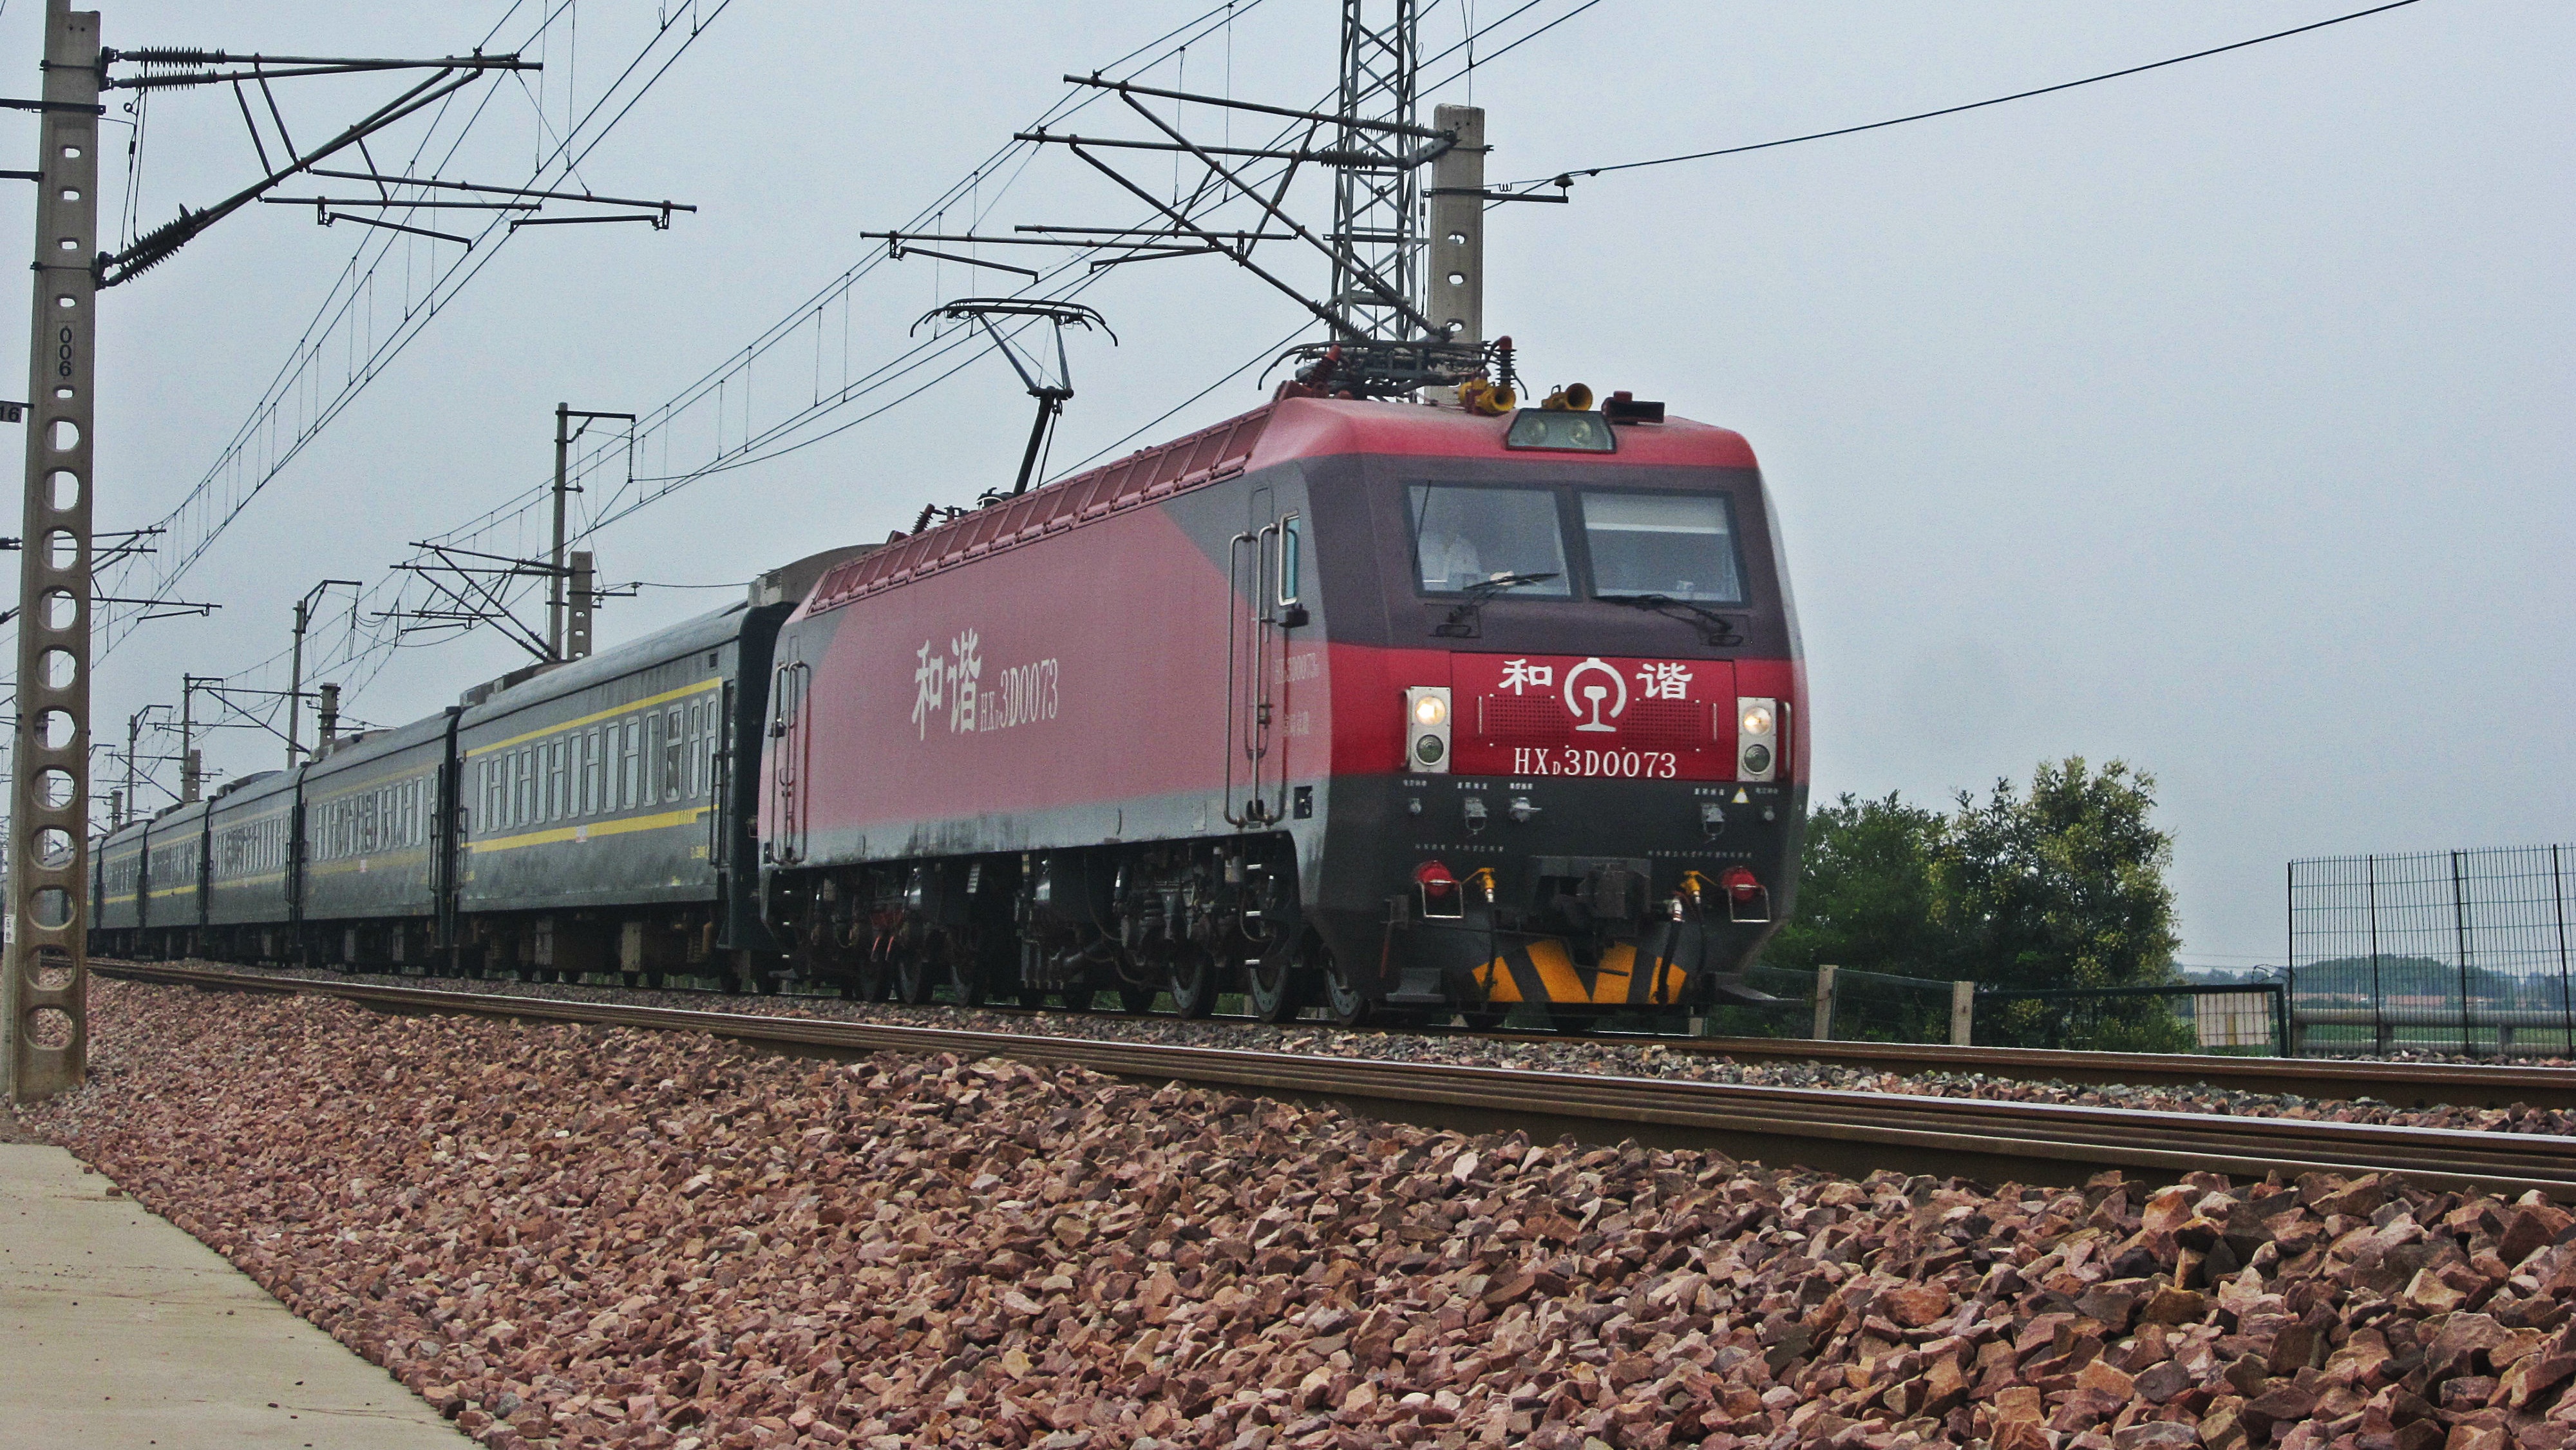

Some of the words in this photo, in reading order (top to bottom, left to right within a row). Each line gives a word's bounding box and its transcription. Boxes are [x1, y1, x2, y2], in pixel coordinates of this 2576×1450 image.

[59, 326, 72, 377] 006
[911, 627, 981, 741] 和谐
[1498, 658, 1553, 696] 和
[1636, 662, 1693, 700] 谐
[1513, 748, 1676, 779] HXD3D0073
